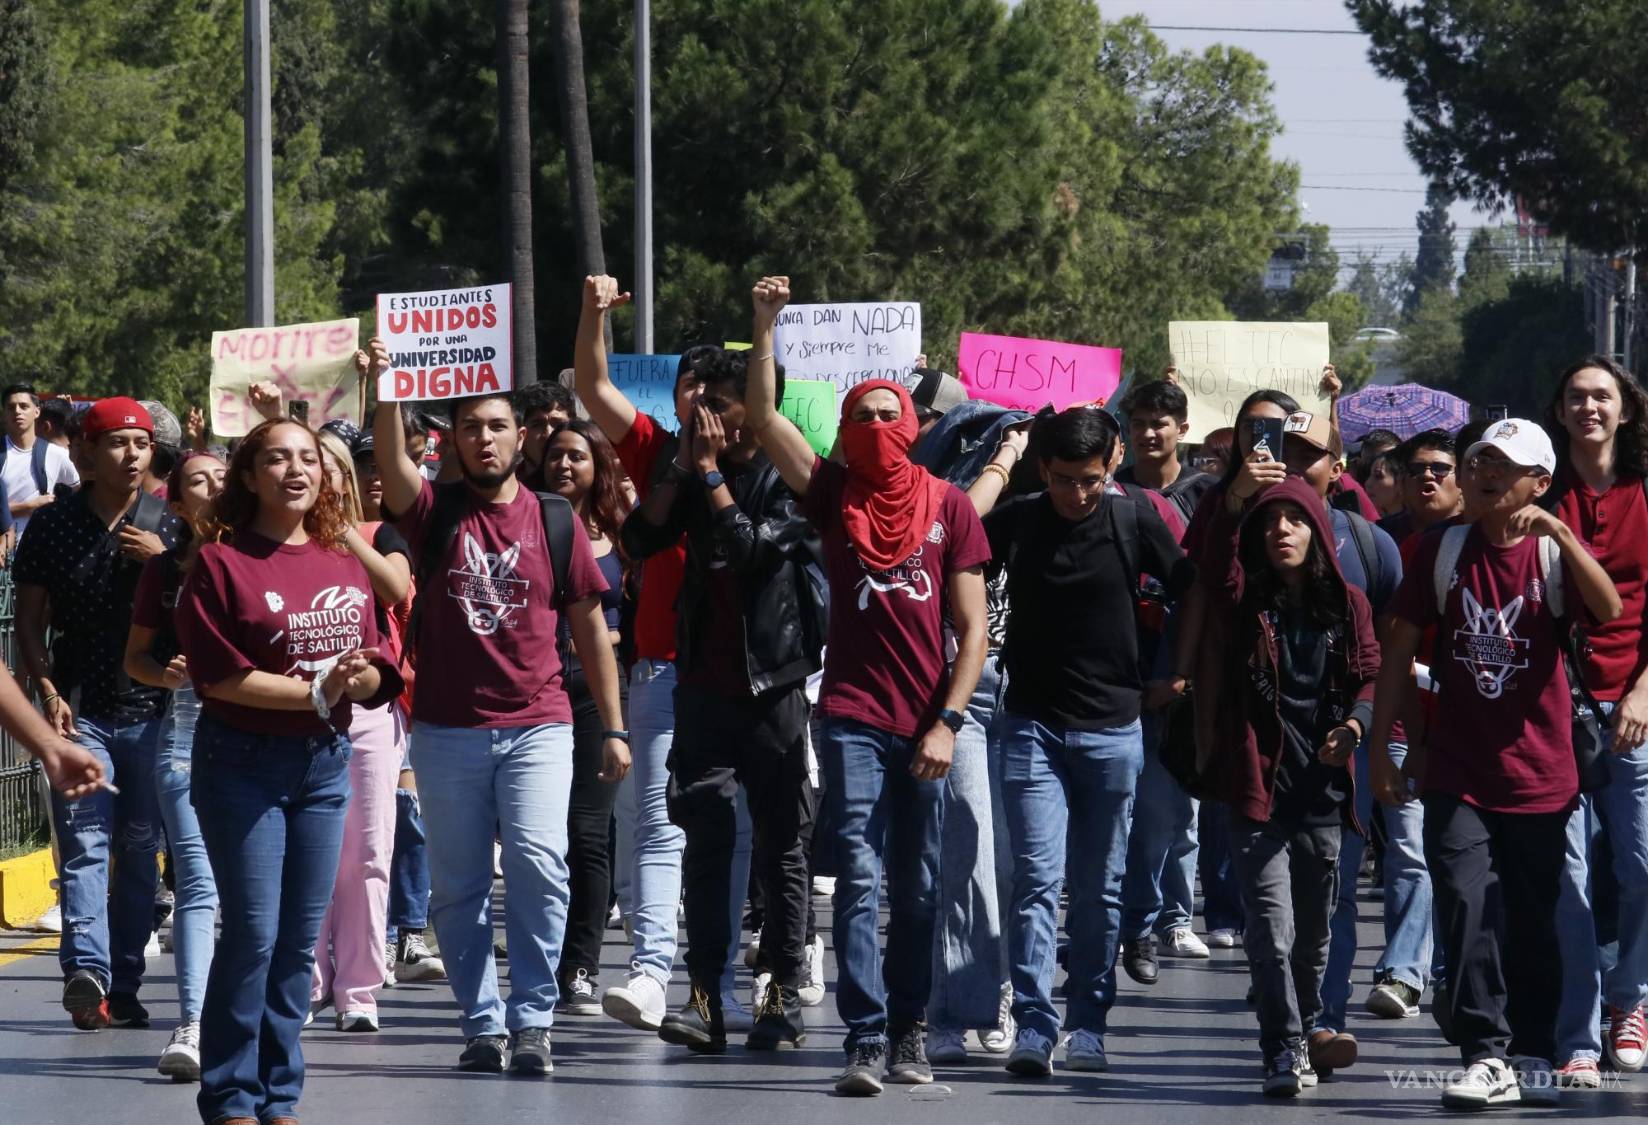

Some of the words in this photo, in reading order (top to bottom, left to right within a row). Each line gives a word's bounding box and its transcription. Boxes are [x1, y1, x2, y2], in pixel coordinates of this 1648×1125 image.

[391, 289, 493, 310] ESTUDIANTES
[388, 303, 497, 334] UNIDOS
[813, 308, 842, 326] DAN
[852, 305, 915, 336] NADA
[419, 336, 440, 347] POR
[445, 334, 468, 345] UNA
[389, 346, 497, 368] UNIVERSIDAD
[394, 362, 501, 399] DIGNA
[608, 359, 671, 382] FUERA
[975, 349, 1076, 393] CHSM
[1177, 367, 1217, 397] NO
[468, 576, 508, 589] INSTITUTO
[463, 590, 476, 598] DE
[477, 591, 510, 604] SALTILLO
[288, 607, 361, 630] INSTITUTO
[289, 623, 360, 641] TECNOLÓGICO
[1470, 635, 1509, 648] INSTITUTO
[288, 643, 304, 655] DE
[307, 636, 358, 654] SALTILLO
[1477, 653, 1512, 664] SALTILLO
